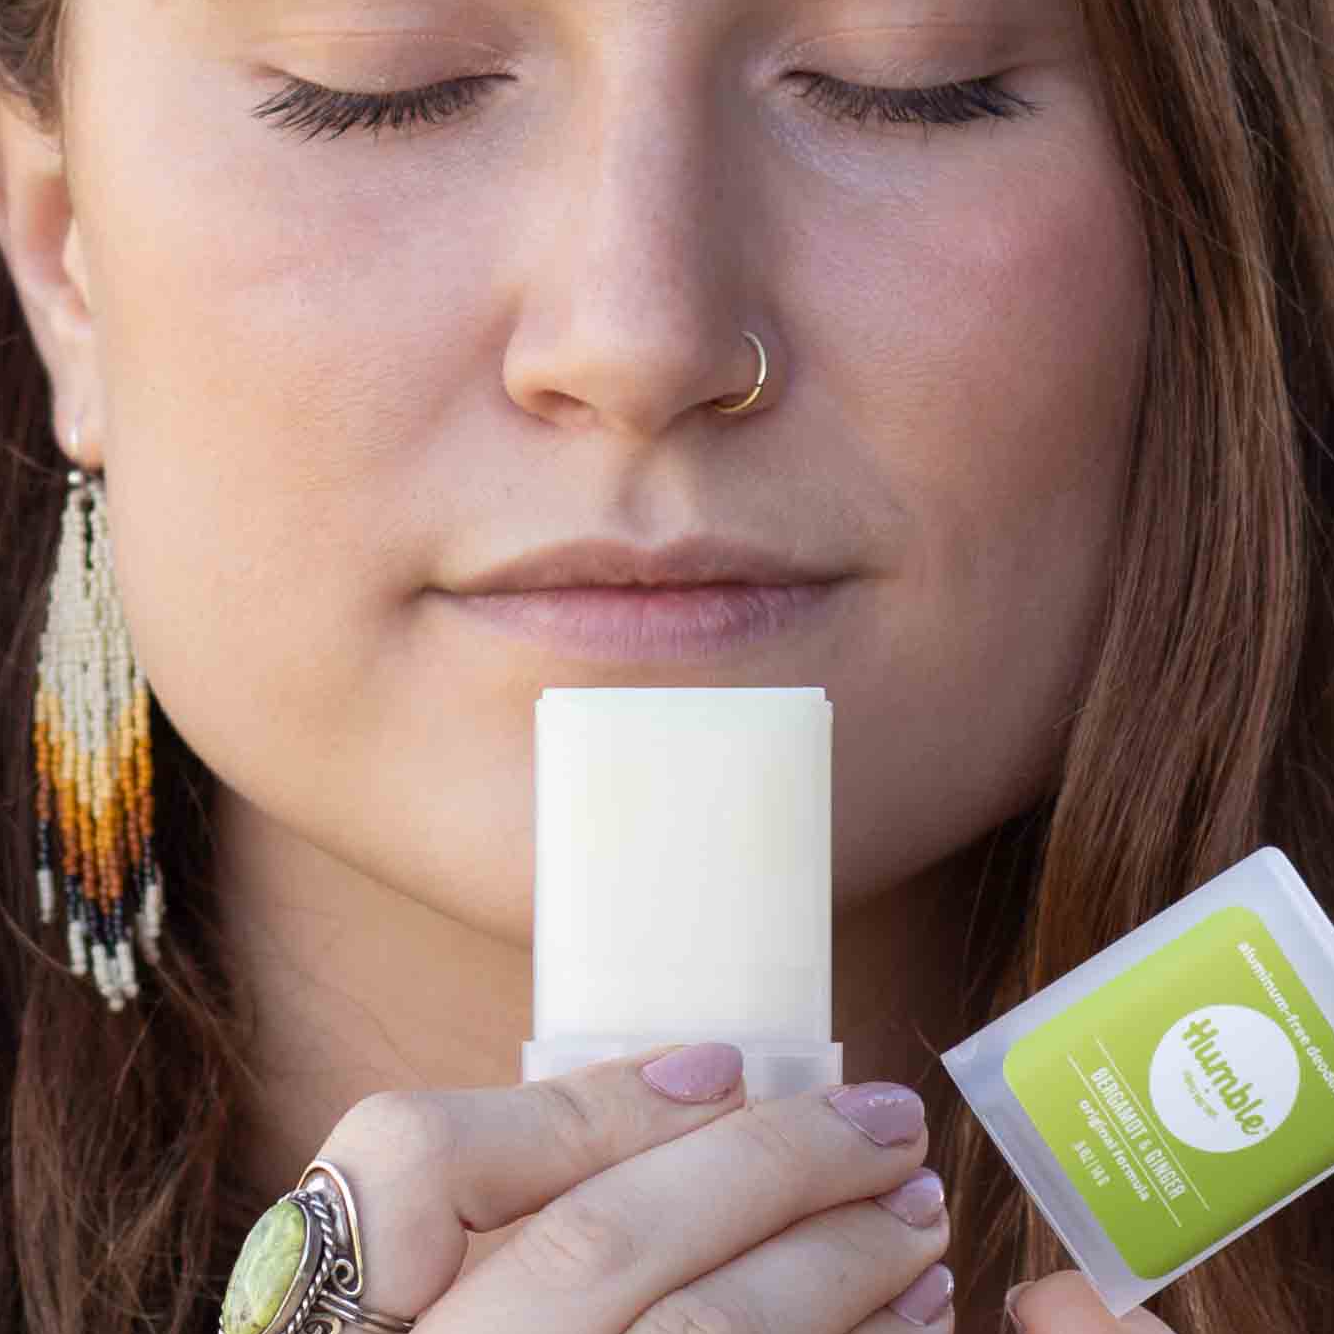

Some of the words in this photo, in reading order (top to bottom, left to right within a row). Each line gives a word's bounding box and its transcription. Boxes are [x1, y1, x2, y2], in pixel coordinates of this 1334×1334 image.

[1236, 940, 1312, 1044] aluminum-free
[1181, 1017, 1268, 1136] Humble
[1091, 1066, 1145, 1138] BERGAMOT
[1144, 1147, 1187, 1200] GINGER
[1112, 1147, 1151, 1202] formula
